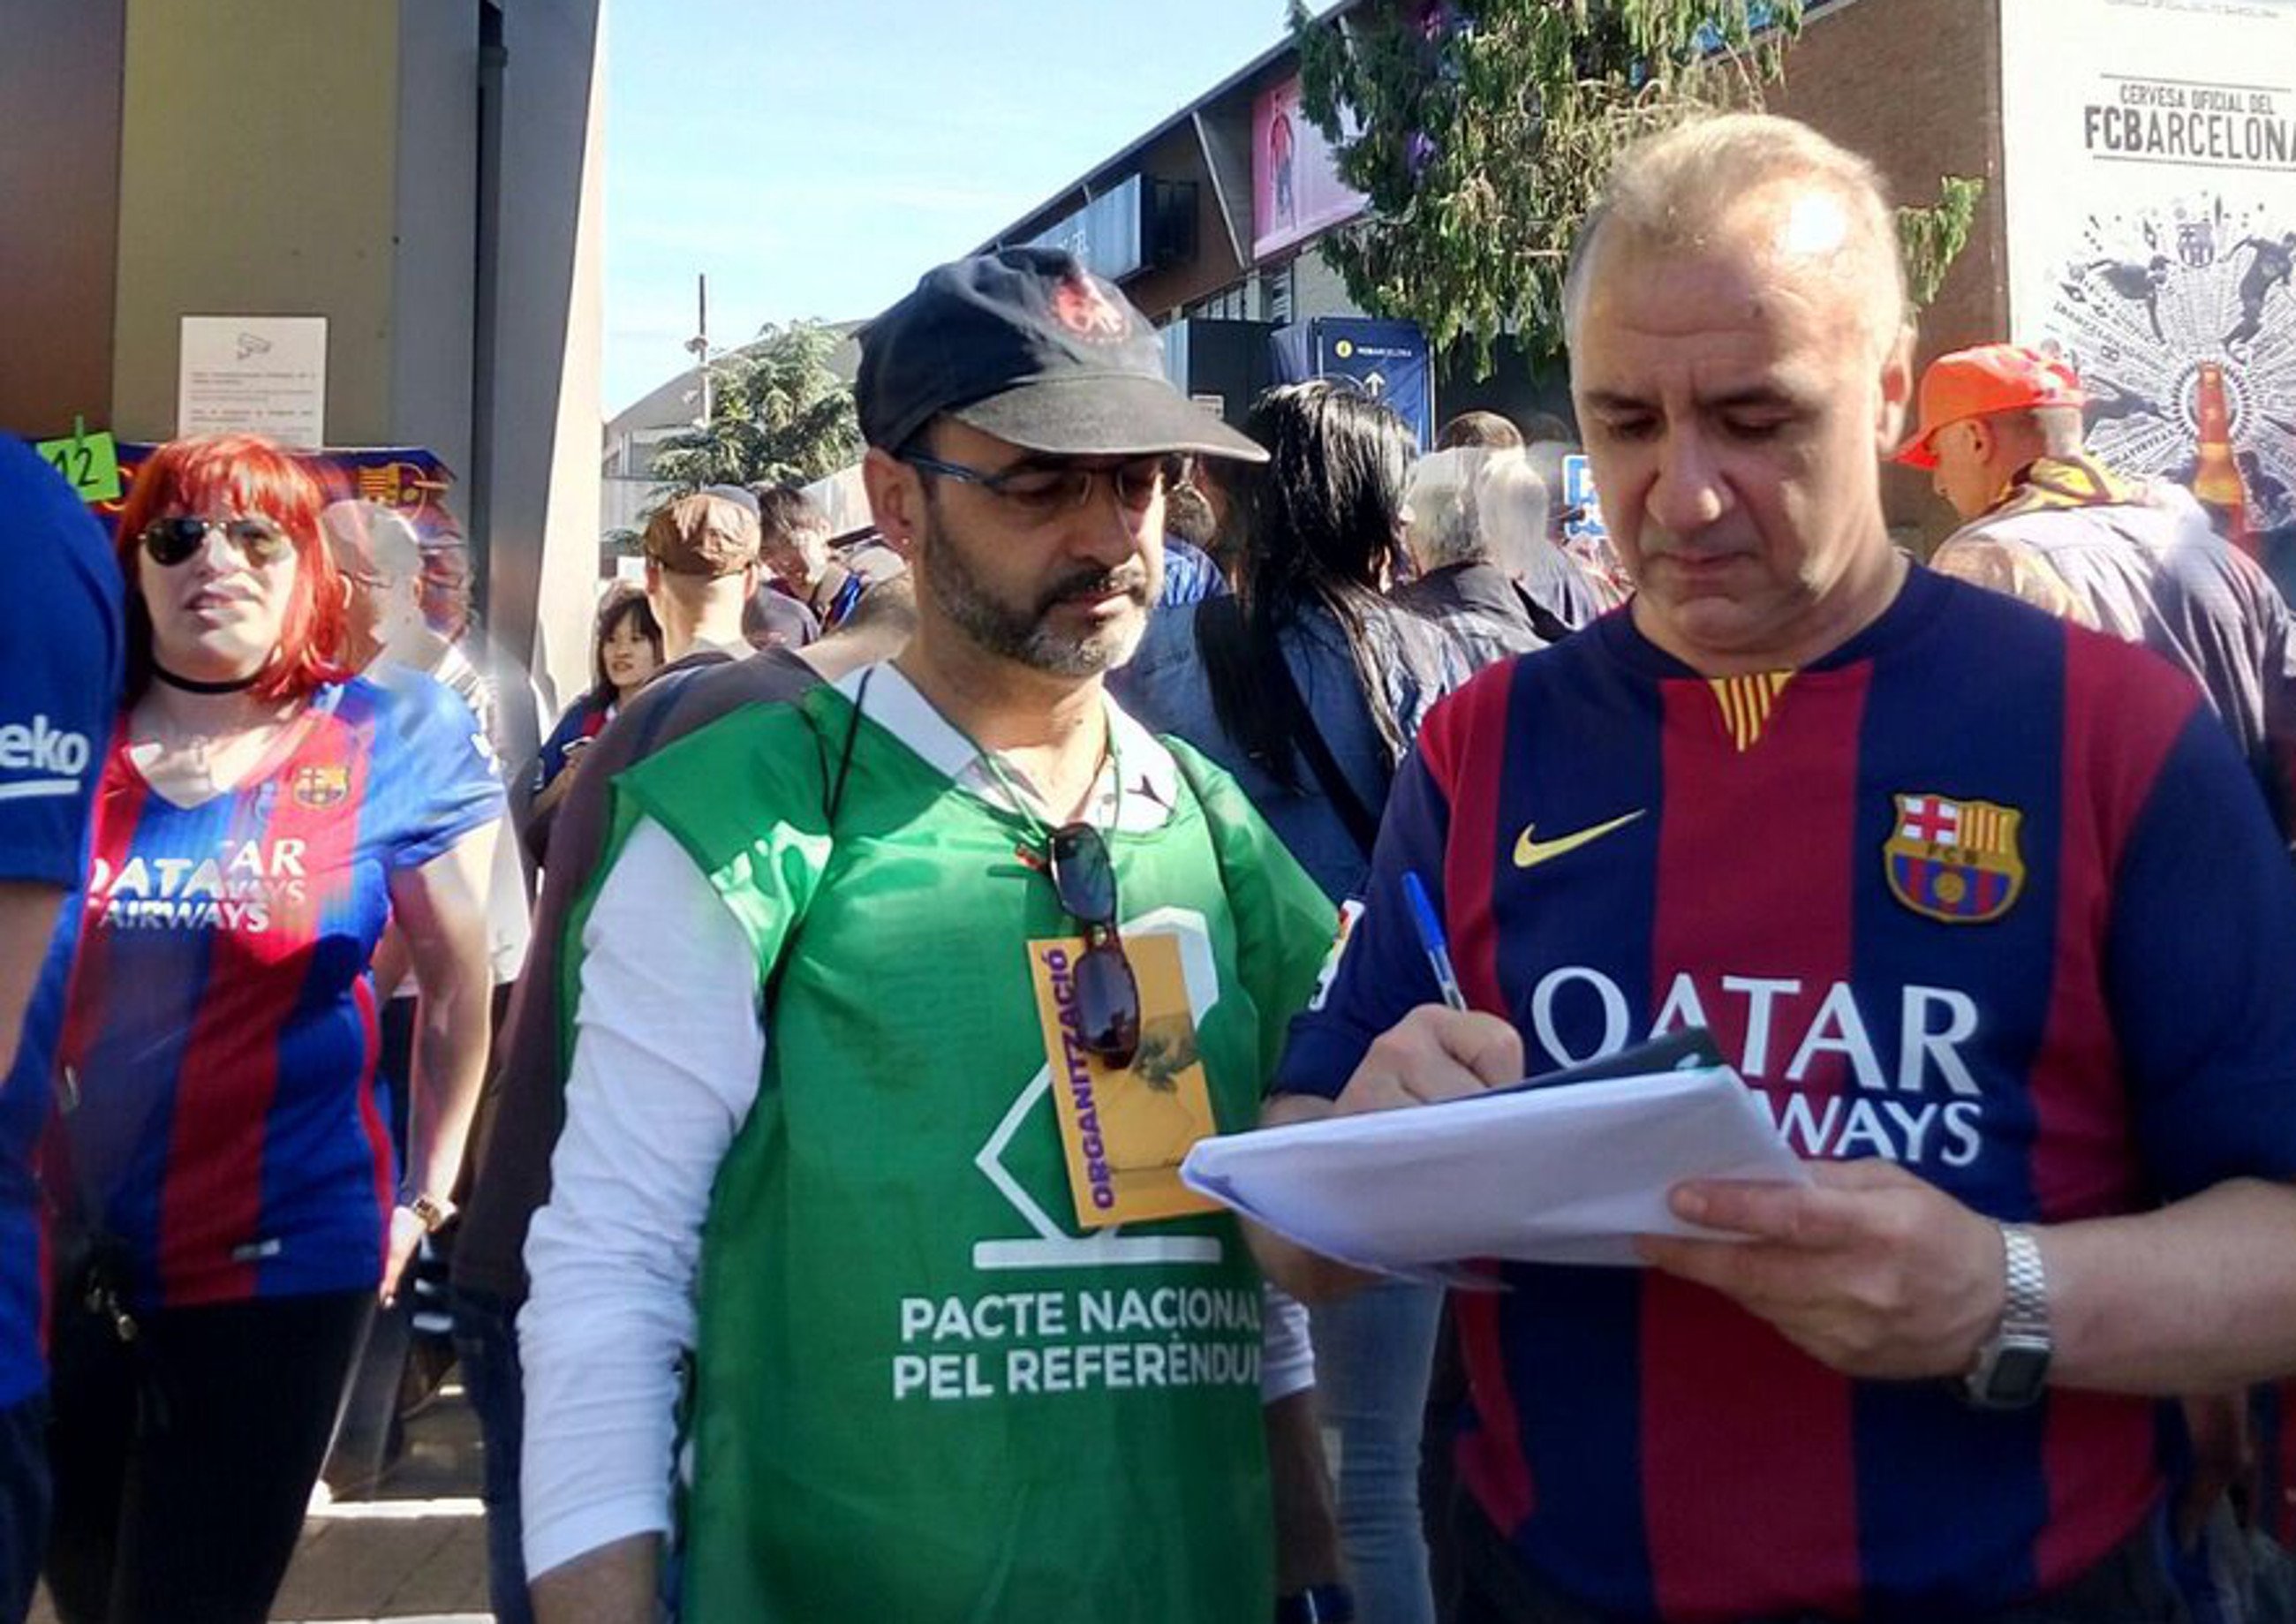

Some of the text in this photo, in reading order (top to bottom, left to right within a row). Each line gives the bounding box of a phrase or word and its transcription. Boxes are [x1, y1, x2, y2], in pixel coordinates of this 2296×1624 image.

[2120, 85, 2276, 115] CERVESA OFICIAL DEL
[54, 448, 100, 487] 12
[1531, 966, 1982, 1095] QATAR
[901, 1292, 1066, 1341] PACTE
[893, 1330, 1261, 1401] PEL REFERÈNDU
